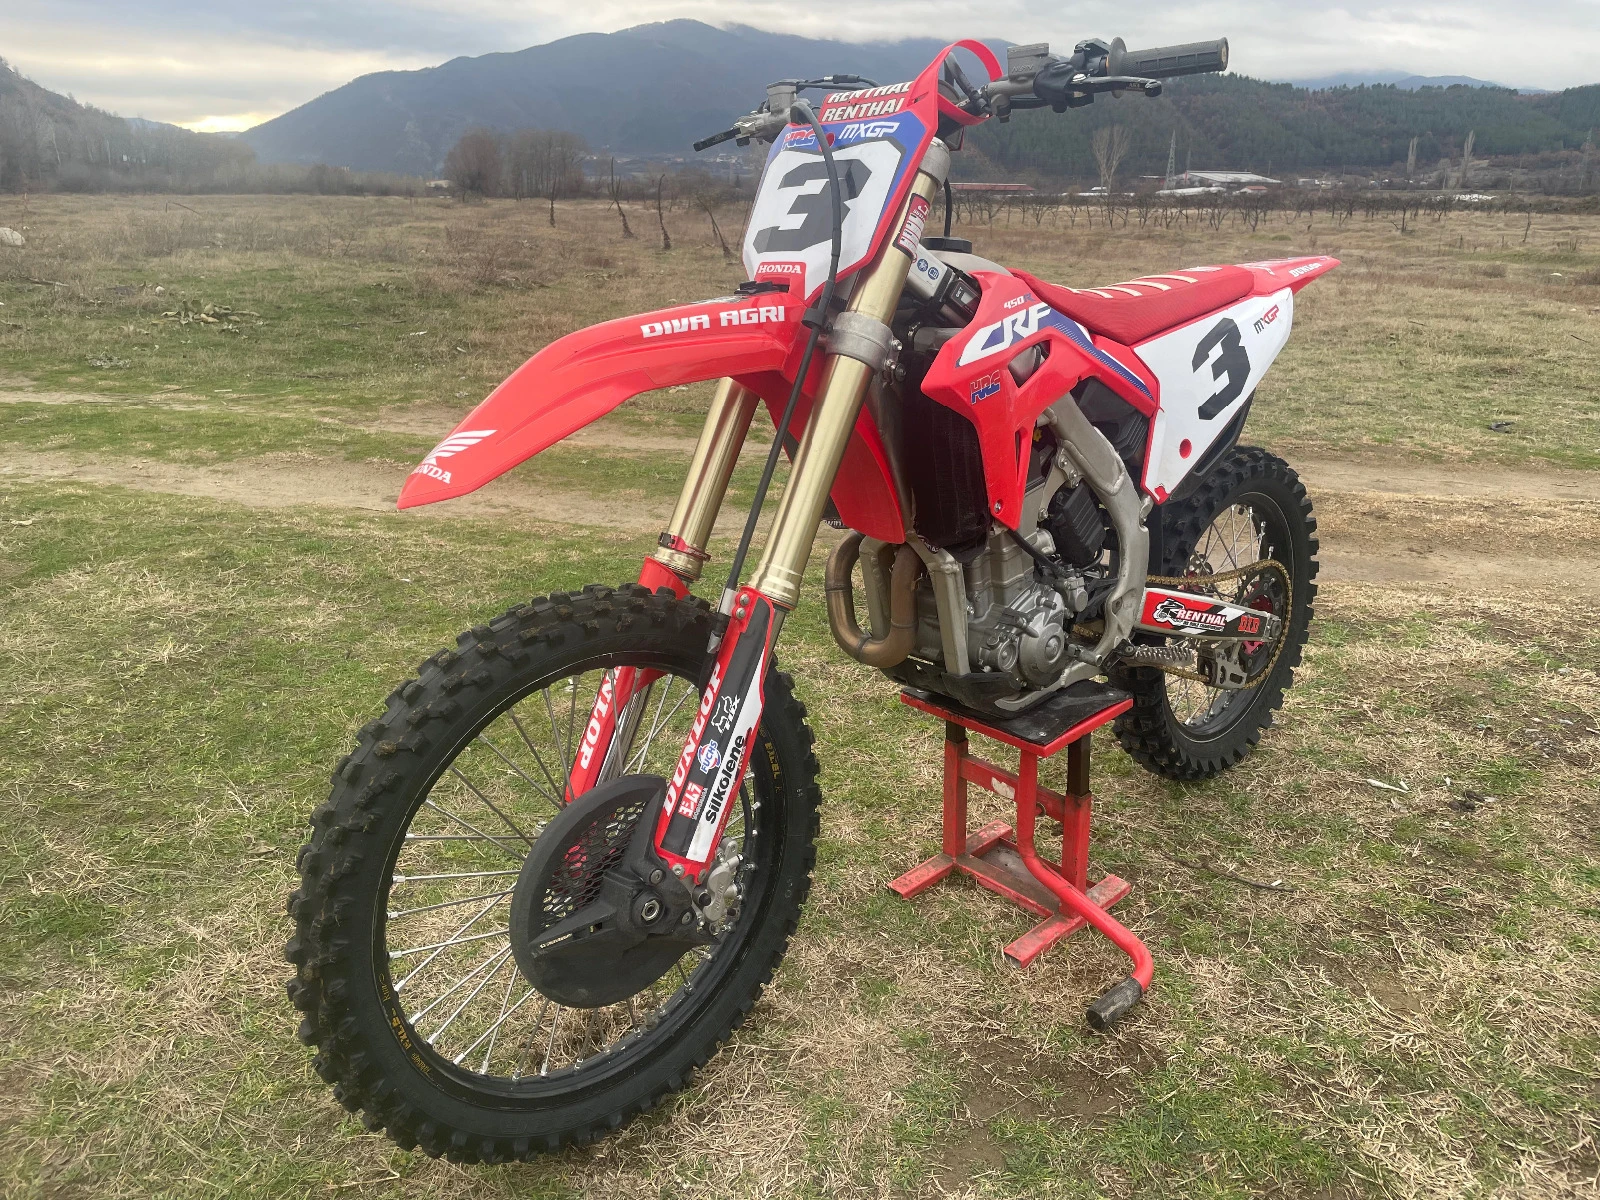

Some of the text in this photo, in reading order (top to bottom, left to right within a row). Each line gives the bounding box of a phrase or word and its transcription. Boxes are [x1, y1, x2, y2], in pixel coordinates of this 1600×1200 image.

[827, 81, 911, 104] RENTHAL
[838, 122, 900, 142] MXGP
[753, 159, 873, 254] 3
[758, 264, 802, 274] HONDA
[1003, 293, 1035, 309] 450R
[640, 306, 785, 338] DIVA AGRI
[958, 302, 1052, 367] CRF
[1253, 304, 1279, 334] MXGP
[1191, 317, 1251, 420] 3
[1175, 607, 1227, 626] RENTHAL
[663, 662, 721, 817] DUNLOP
[700, 739, 718, 774] FUCHS
[705, 735, 745, 825] Silkolene
